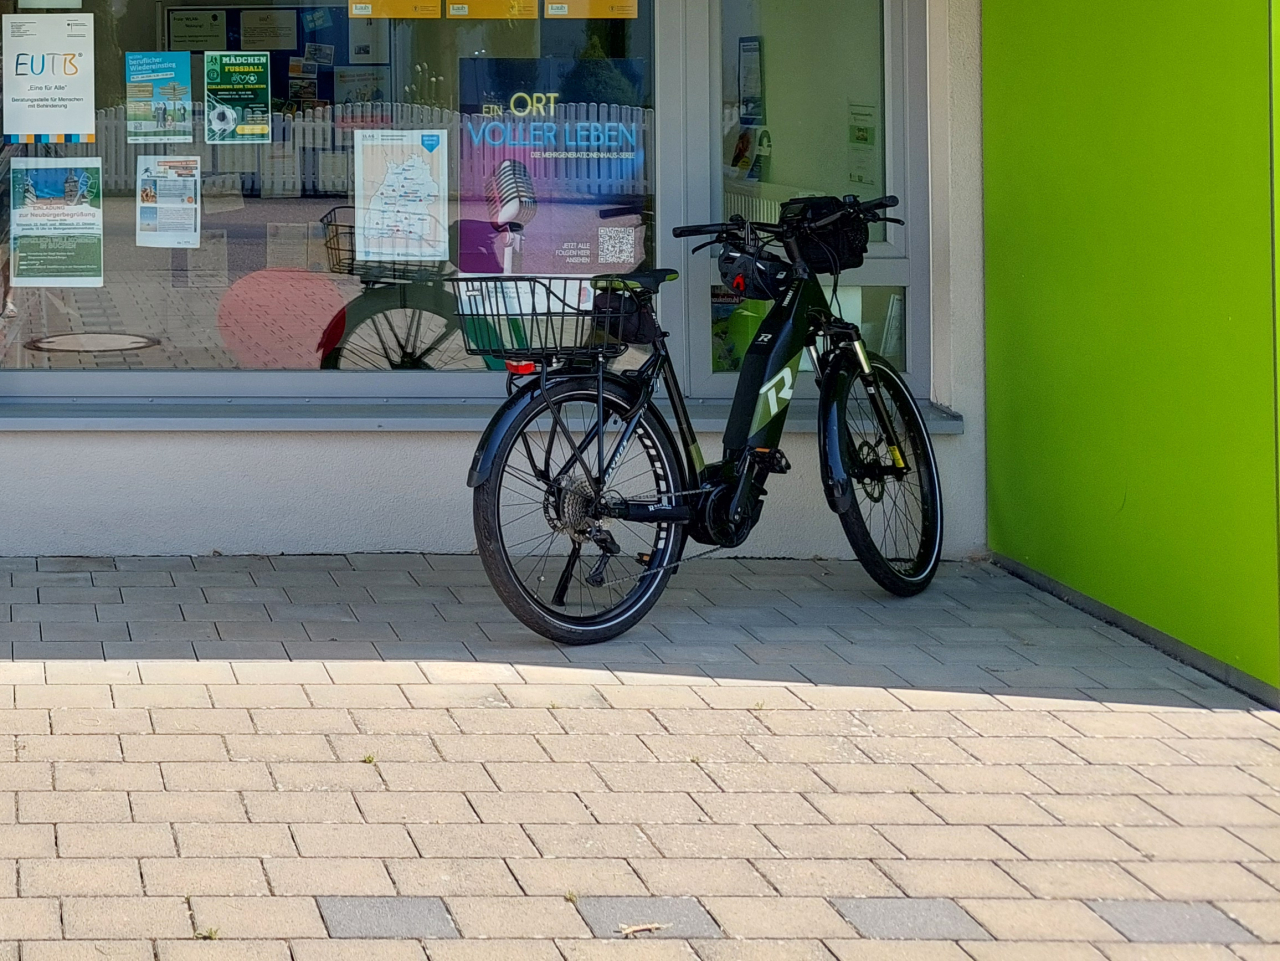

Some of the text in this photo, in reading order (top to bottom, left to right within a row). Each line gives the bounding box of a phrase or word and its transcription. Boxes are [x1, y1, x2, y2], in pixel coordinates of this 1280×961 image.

[128, 57, 162, 65] beruflicher
[222, 55, 267, 64] MÄDCHEN
[129, 62, 177, 71] Wiedereinstieg
[482, 92, 560, 117] EIN ORT
[467, 121, 636, 147] VOLLER LEBEN
[29, 211, 96, 219] Neubürgerbegrüßung
